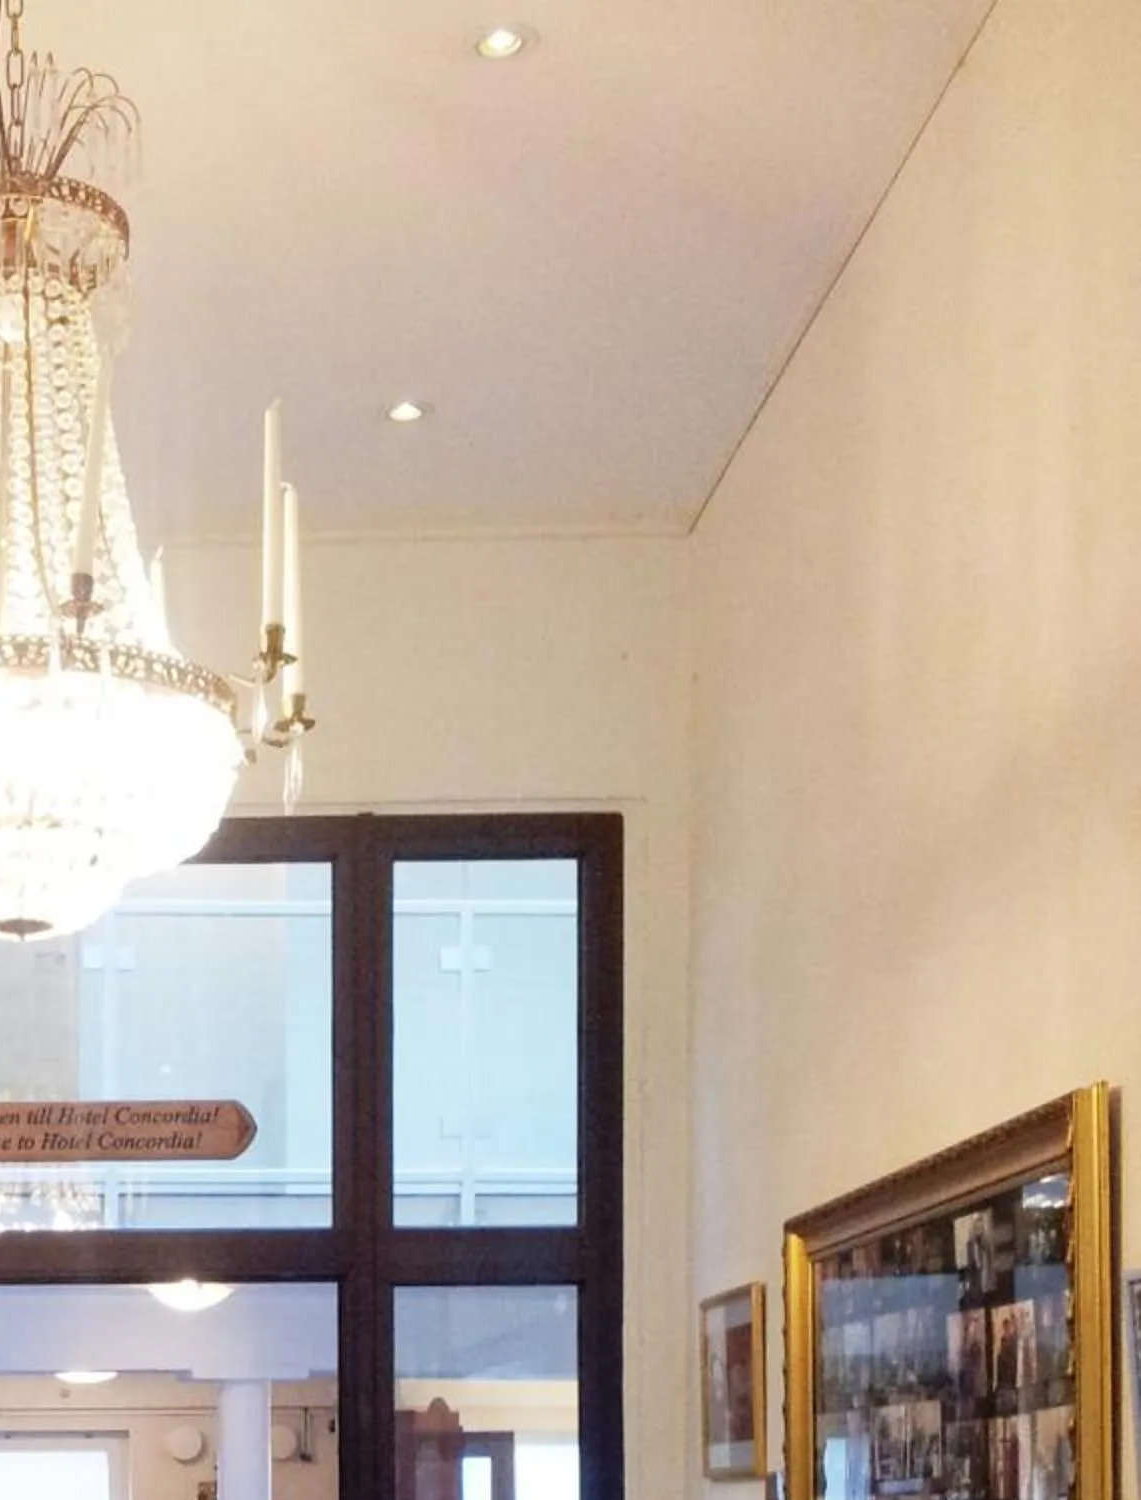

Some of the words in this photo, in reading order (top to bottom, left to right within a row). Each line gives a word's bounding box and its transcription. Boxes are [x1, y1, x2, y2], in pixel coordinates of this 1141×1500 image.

[27, 1107, 53, 1125] till
[58, 1107, 109, 1126] Hotel
[114, 1106, 221, 1125] Concordia!
[17, 1135, 36, 1151] to
[41, 1132, 93, 1151] Hotel
[97, 1132, 203, 1150] Concordia!
